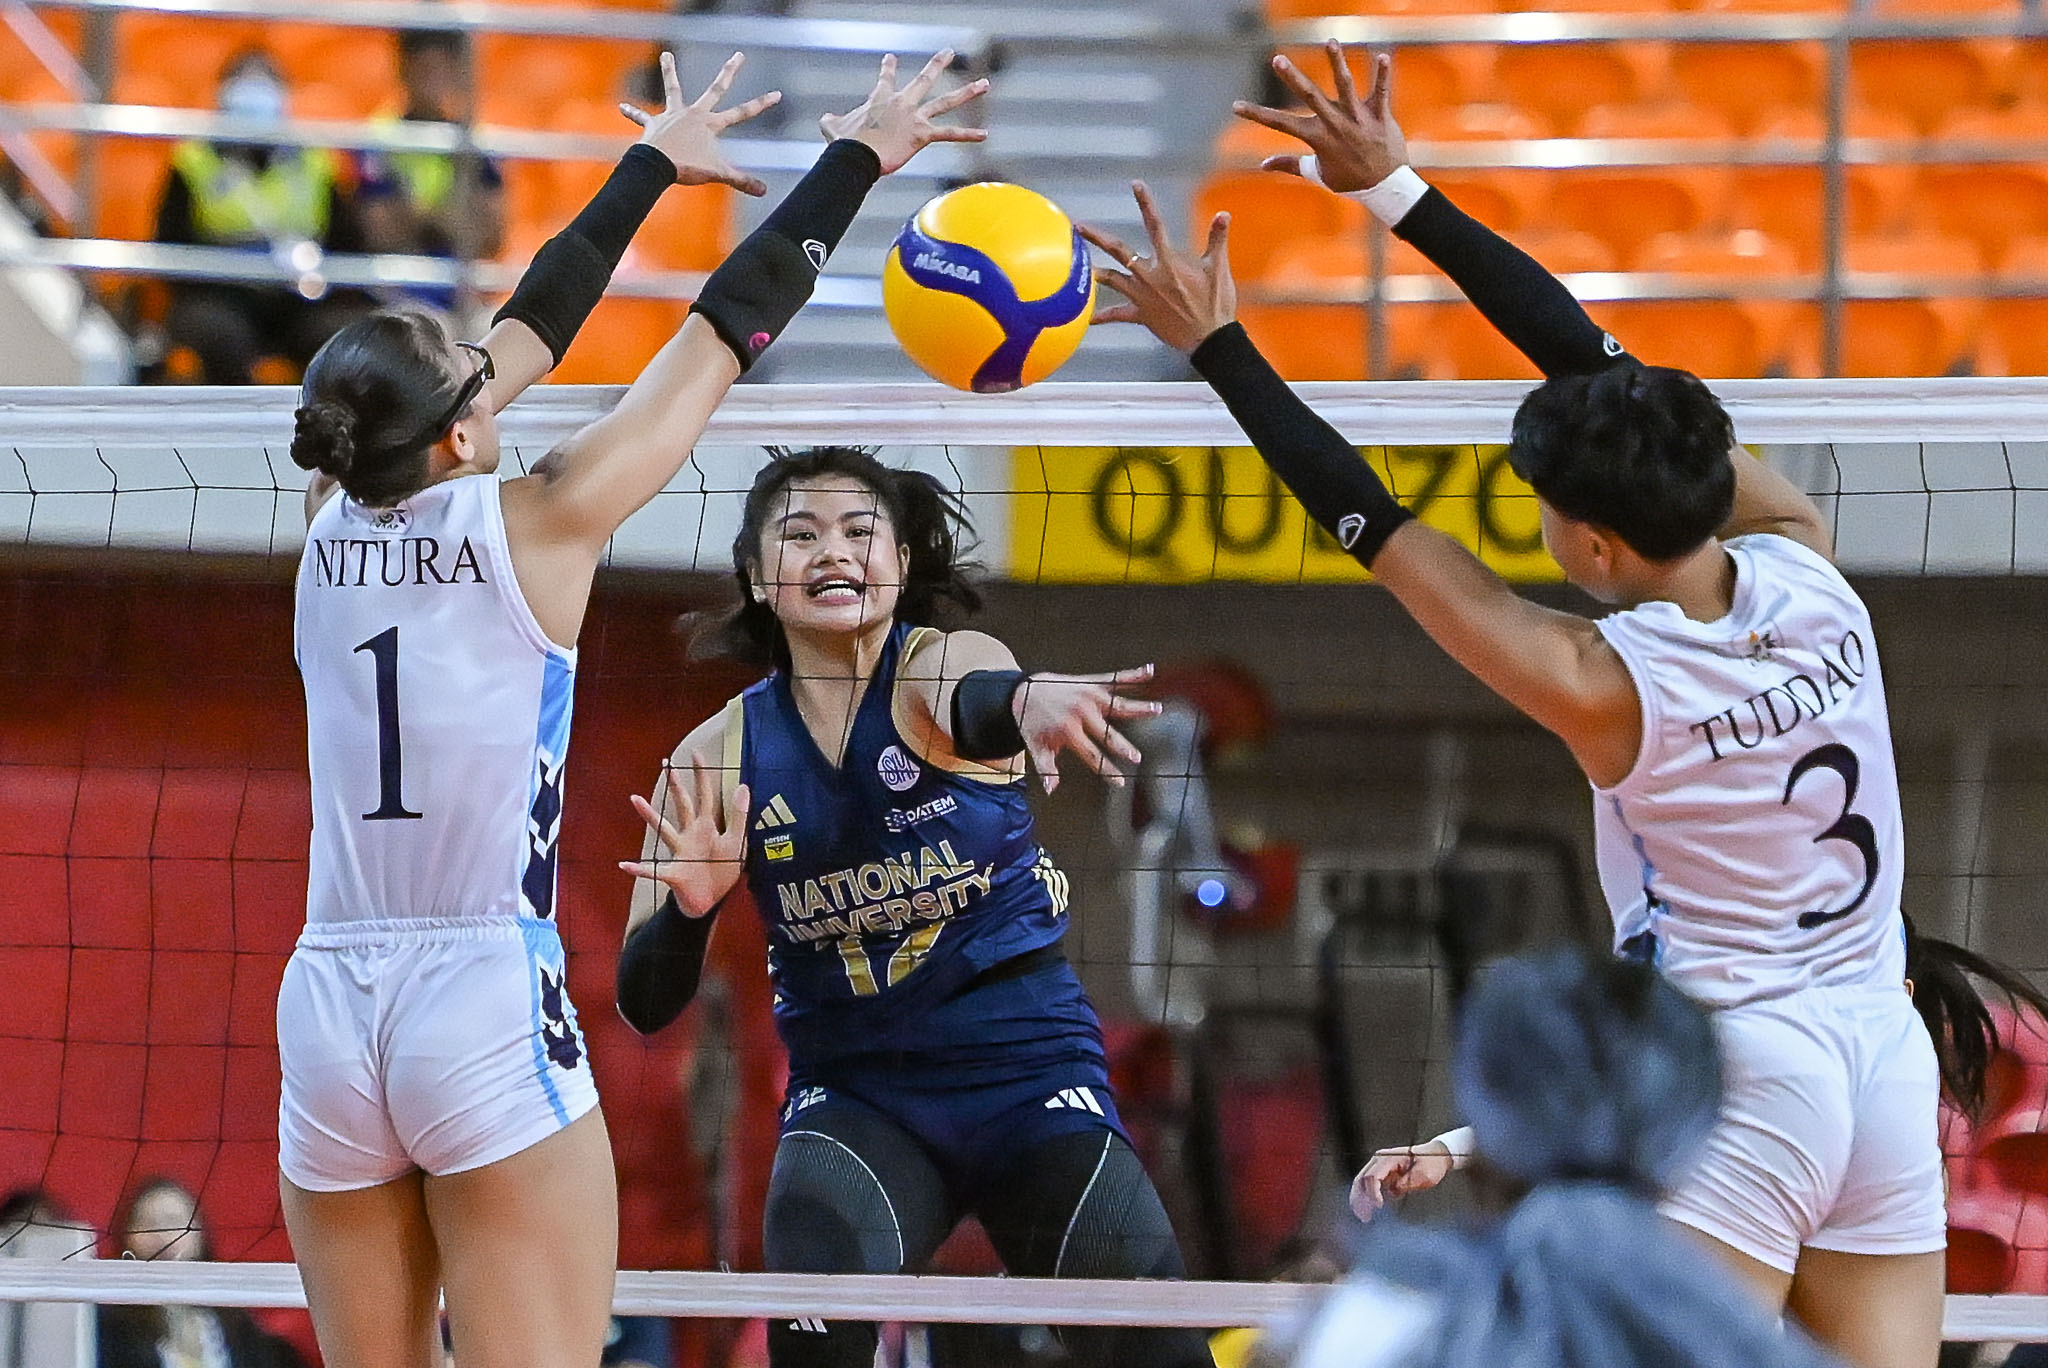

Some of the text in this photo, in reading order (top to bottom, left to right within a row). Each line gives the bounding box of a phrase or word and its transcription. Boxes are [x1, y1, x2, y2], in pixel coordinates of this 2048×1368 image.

[313, 535, 487, 588] NITURA
[353, 625, 423, 820] 1
[1689, 630, 1866, 763] TUDDAO
[778, 840, 974, 921] NATIONAL
[1781, 742, 1881, 930] 3
